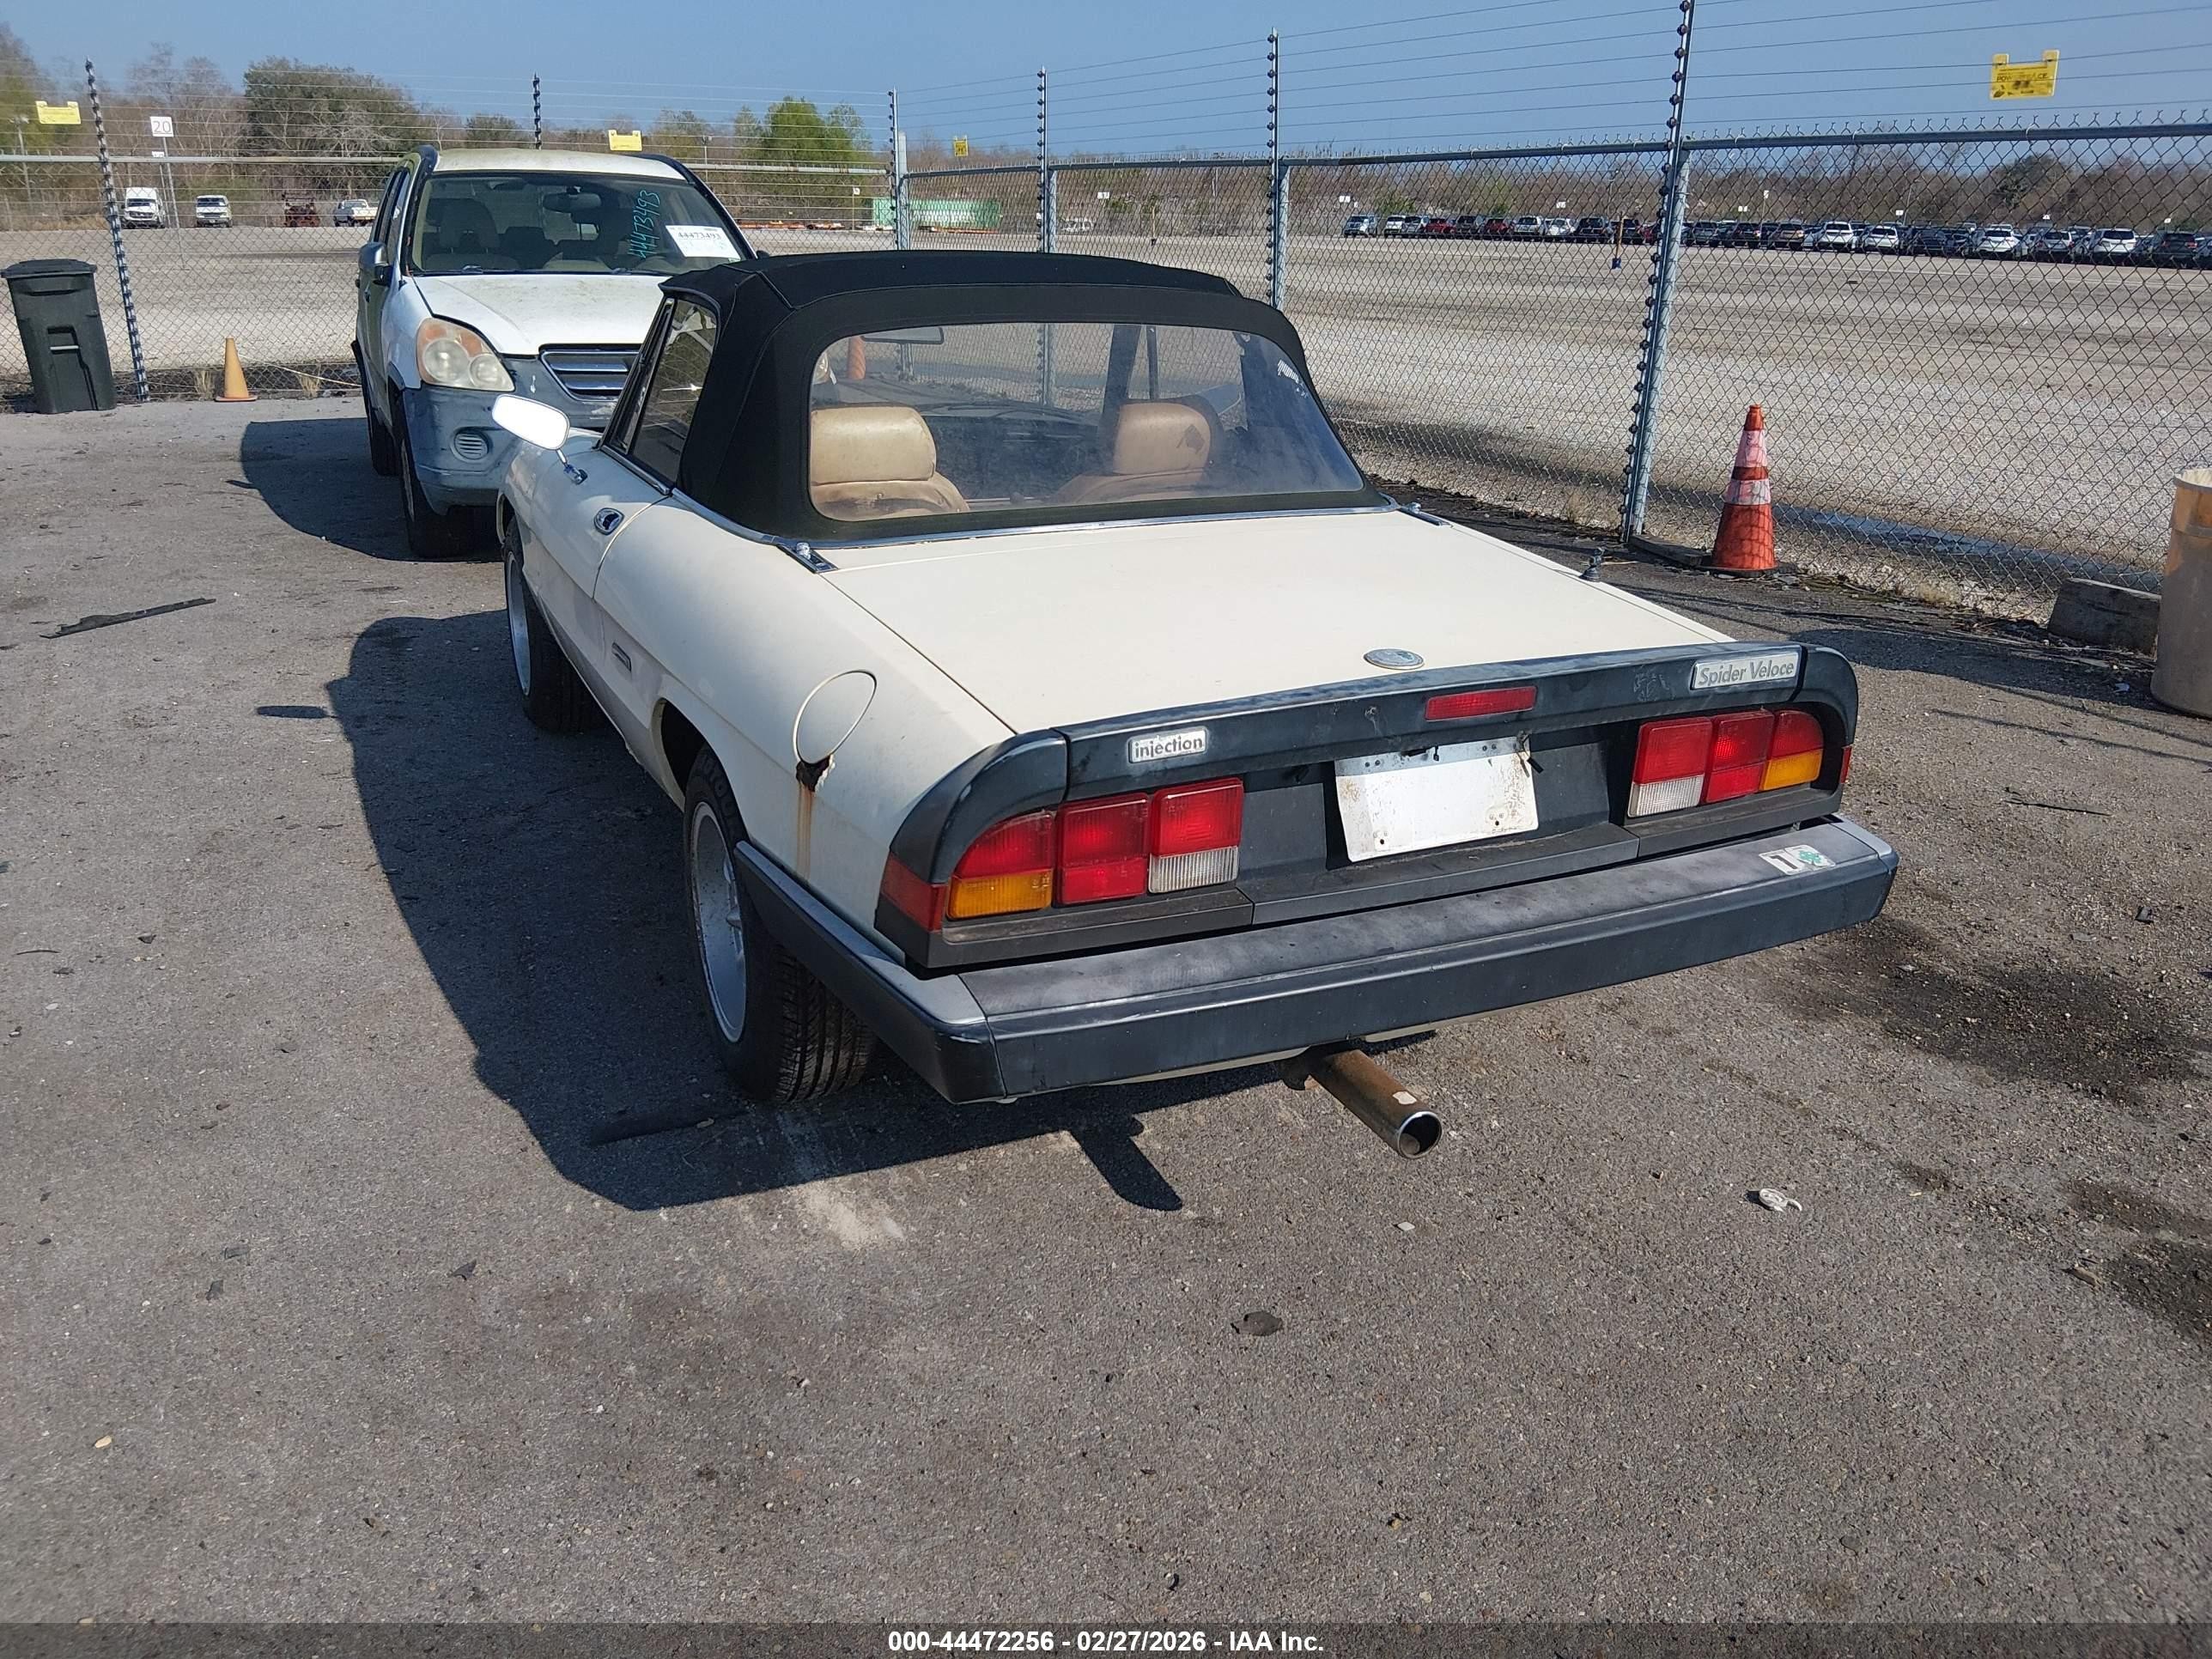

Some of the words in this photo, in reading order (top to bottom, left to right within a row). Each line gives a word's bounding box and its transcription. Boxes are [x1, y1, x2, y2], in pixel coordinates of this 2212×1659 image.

[153, 120, 171, 133] 20
[628, 190, 659, 258] 44473493
[1698, 664, 1747, 686] Spider
[1750, 659, 1794, 680] Veloce
[1134, 736, 1203, 758] injection
